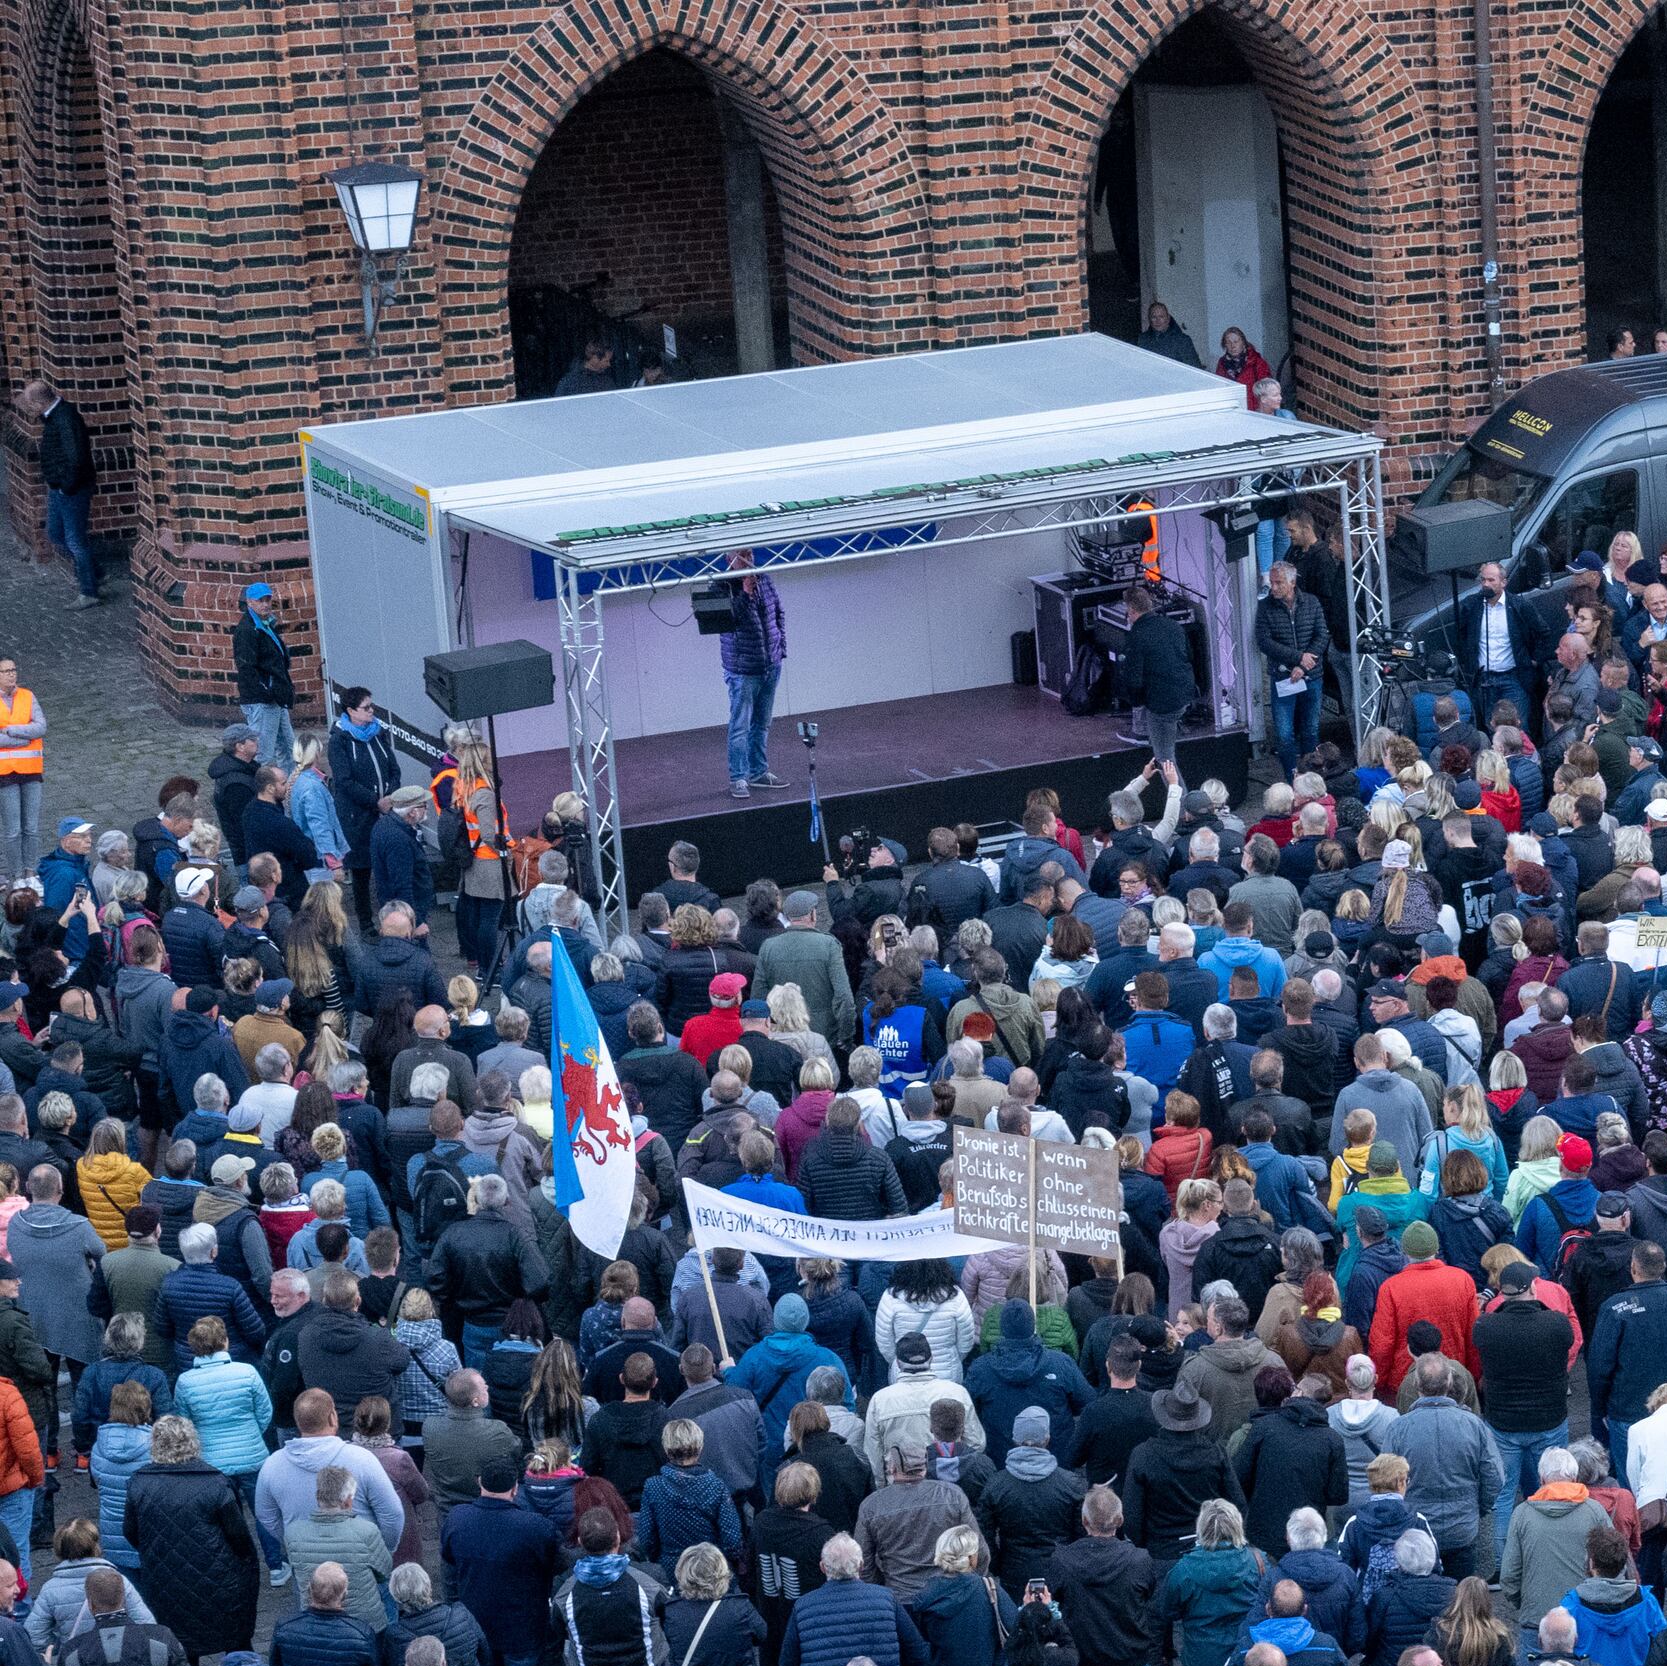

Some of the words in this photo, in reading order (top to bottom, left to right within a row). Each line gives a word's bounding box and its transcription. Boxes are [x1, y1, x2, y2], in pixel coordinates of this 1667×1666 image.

[1512, 410, 1553, 432] HELLCON
[337, 493, 358, 513] Event
[1003, 1140, 1026, 1161] ist,
[1043, 1152, 1087, 1170] wenn
[959, 1154, 1025, 1184] Politiker
[1043, 1172, 1084, 1196] ohne
[958, 1206, 1029, 1235] Fachkräfte
